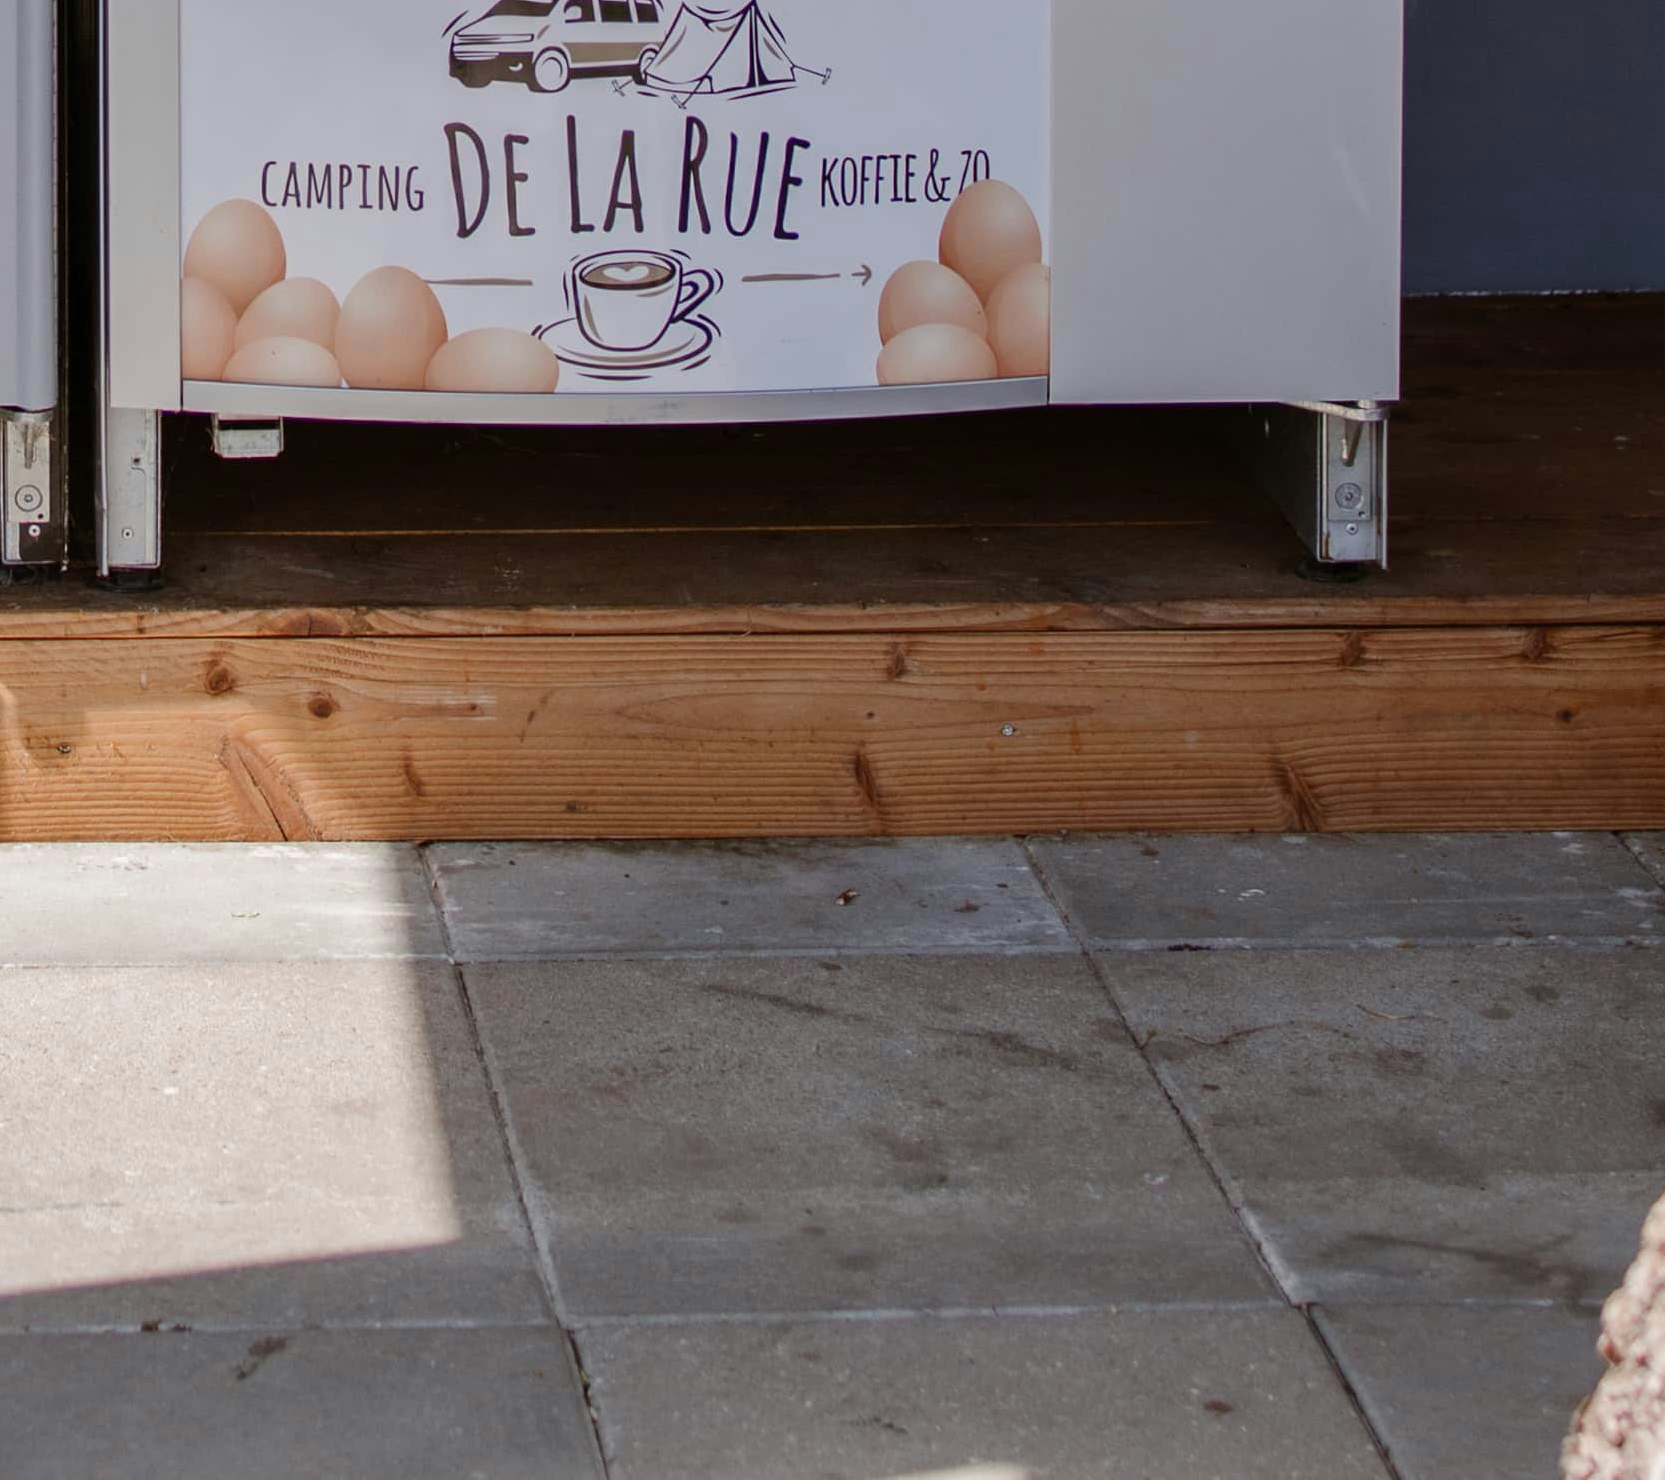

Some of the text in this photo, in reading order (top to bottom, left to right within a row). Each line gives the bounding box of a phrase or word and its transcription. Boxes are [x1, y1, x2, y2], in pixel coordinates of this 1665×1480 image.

[260, 160, 425, 212] CAMPING
[443, 122, 537, 239] DE
[566, 114, 645, 234] LA
[678, 115, 811, 241] RUE
[821, 153, 917, 208] KOFFIE
[924, 148, 952, 203] &
